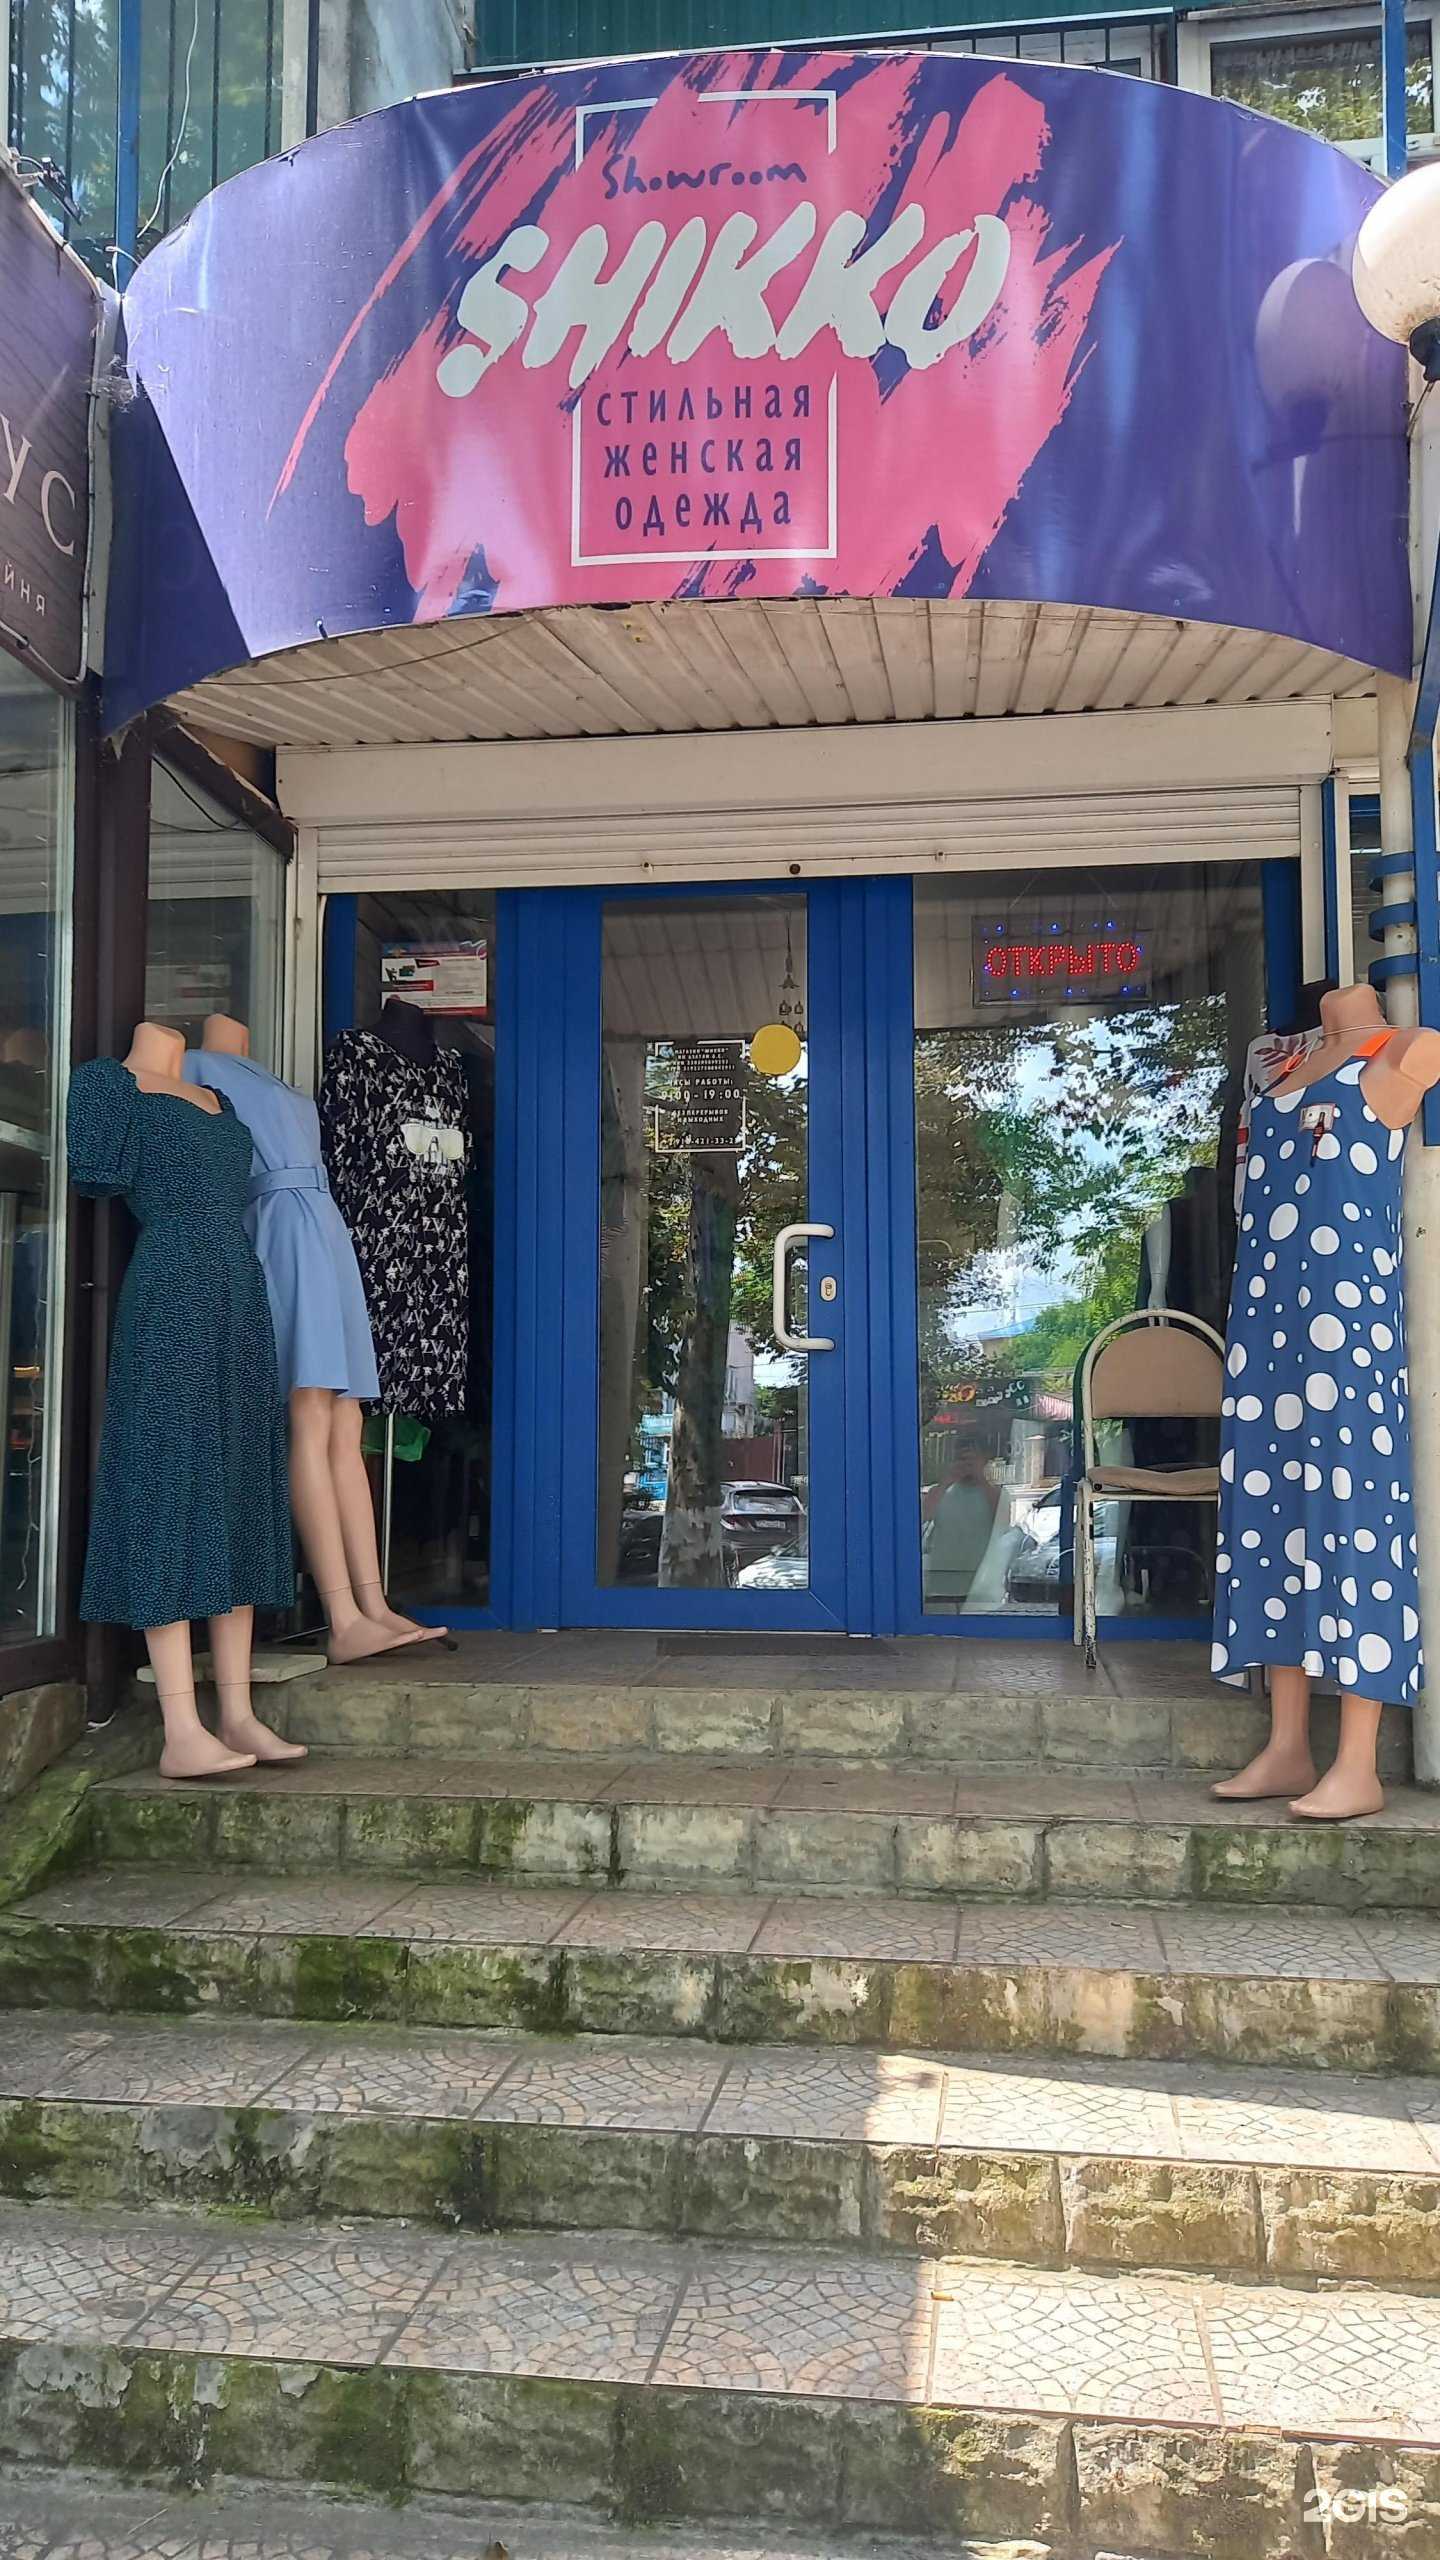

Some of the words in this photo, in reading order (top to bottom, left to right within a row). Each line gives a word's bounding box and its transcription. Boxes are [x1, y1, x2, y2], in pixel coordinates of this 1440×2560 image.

[602, 155, 808, 198] Showroom
[435, 201, 1011, 398] SHIKKO
[597, 383, 811, 427] стильная
[604, 436, 802, 478] женская
[614, 490, 792, 536] одежда
[987, 943, 1137, 975] ОТКРЫТО
